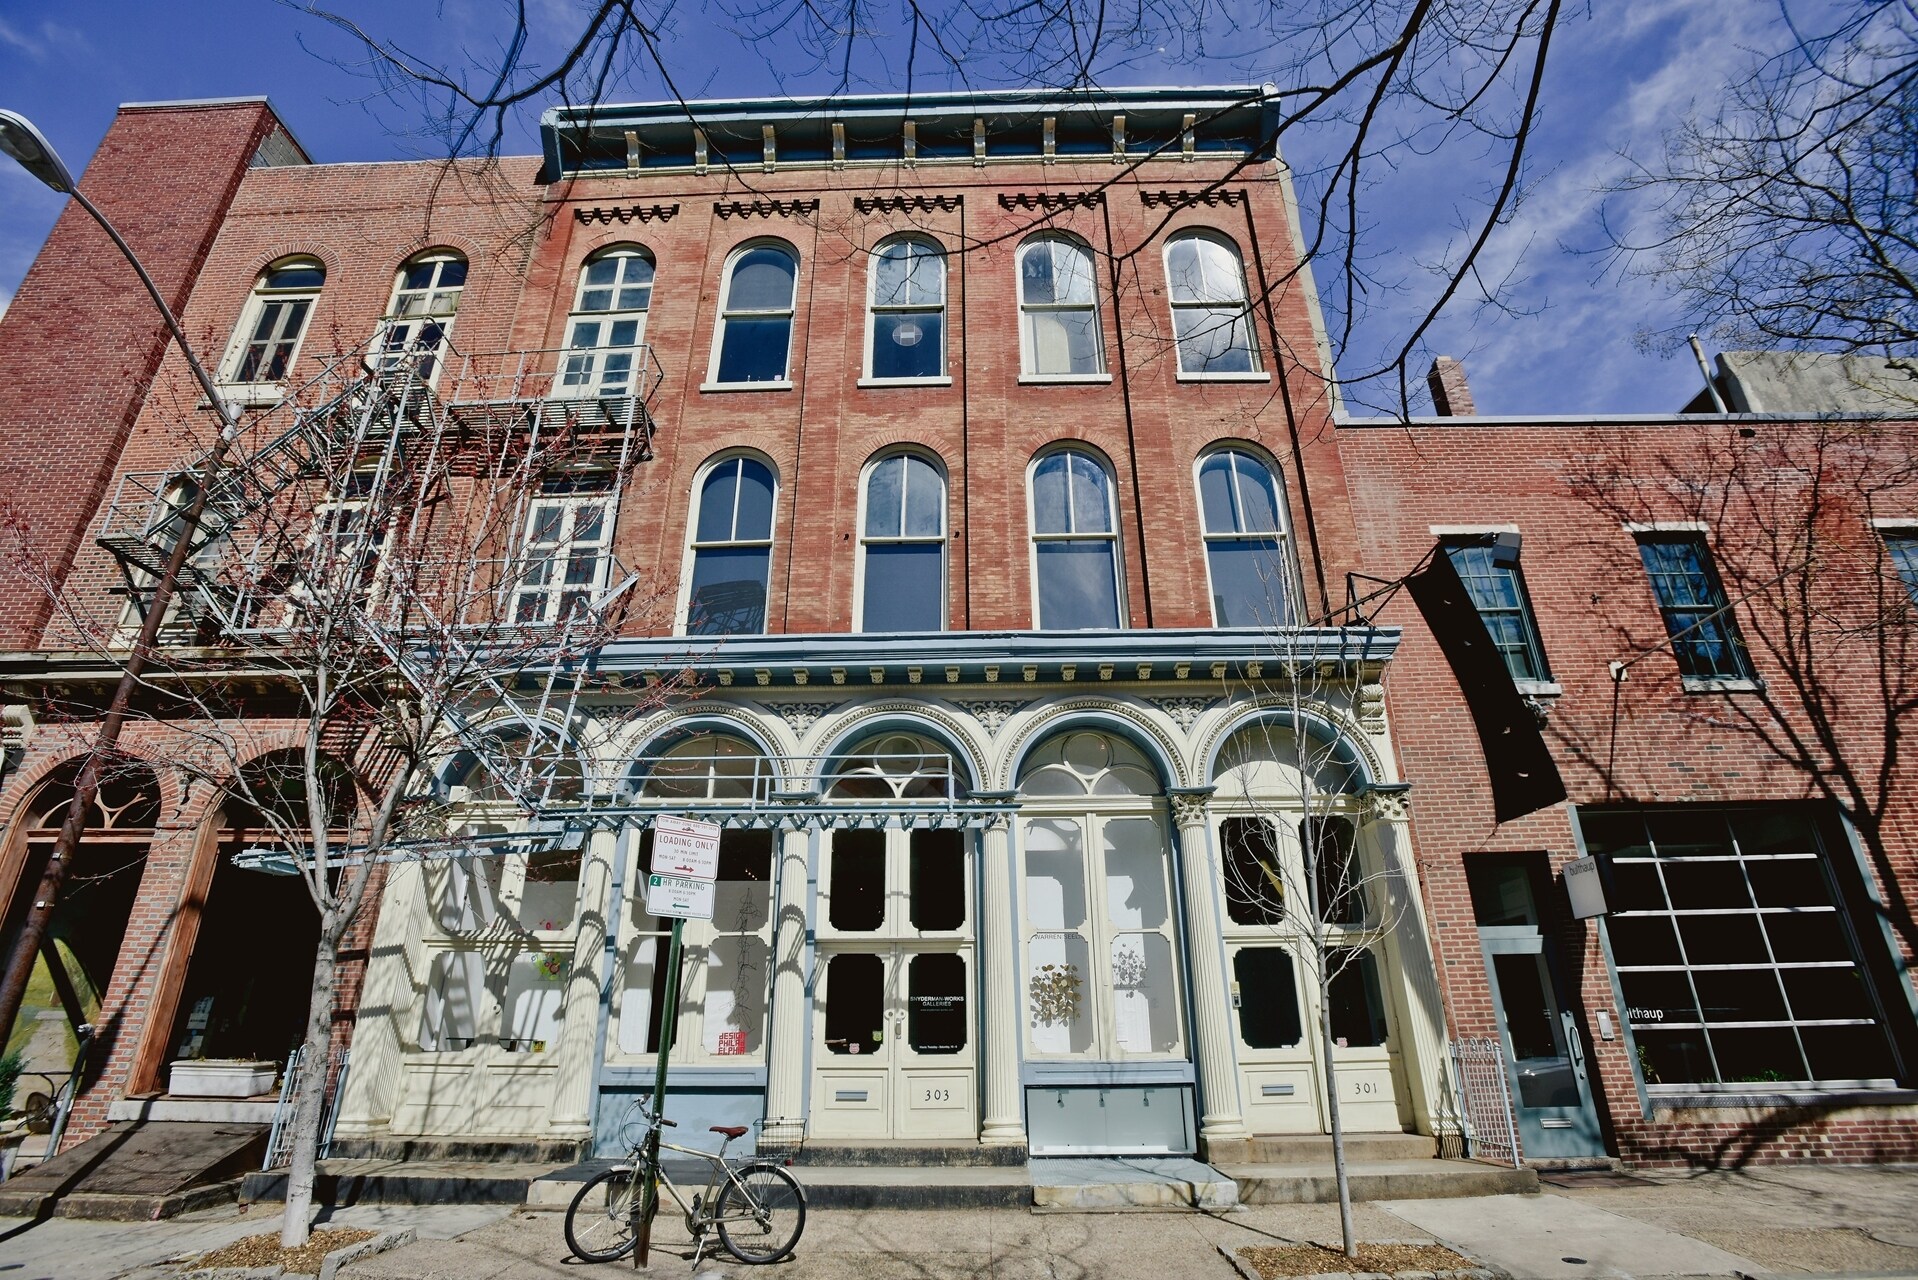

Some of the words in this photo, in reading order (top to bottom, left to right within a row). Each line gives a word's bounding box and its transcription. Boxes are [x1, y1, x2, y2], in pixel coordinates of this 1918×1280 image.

[659, 835, 692, 847] LOADING
[696, 840, 714, 850] ONLY
[653, 876, 658, 886] 2
[662, 878, 672, 887] HR
[675, 880, 705, 891] PARKING
[924, 1089, 949, 1101] 303
[1355, 1082, 1377, 1095] 301
